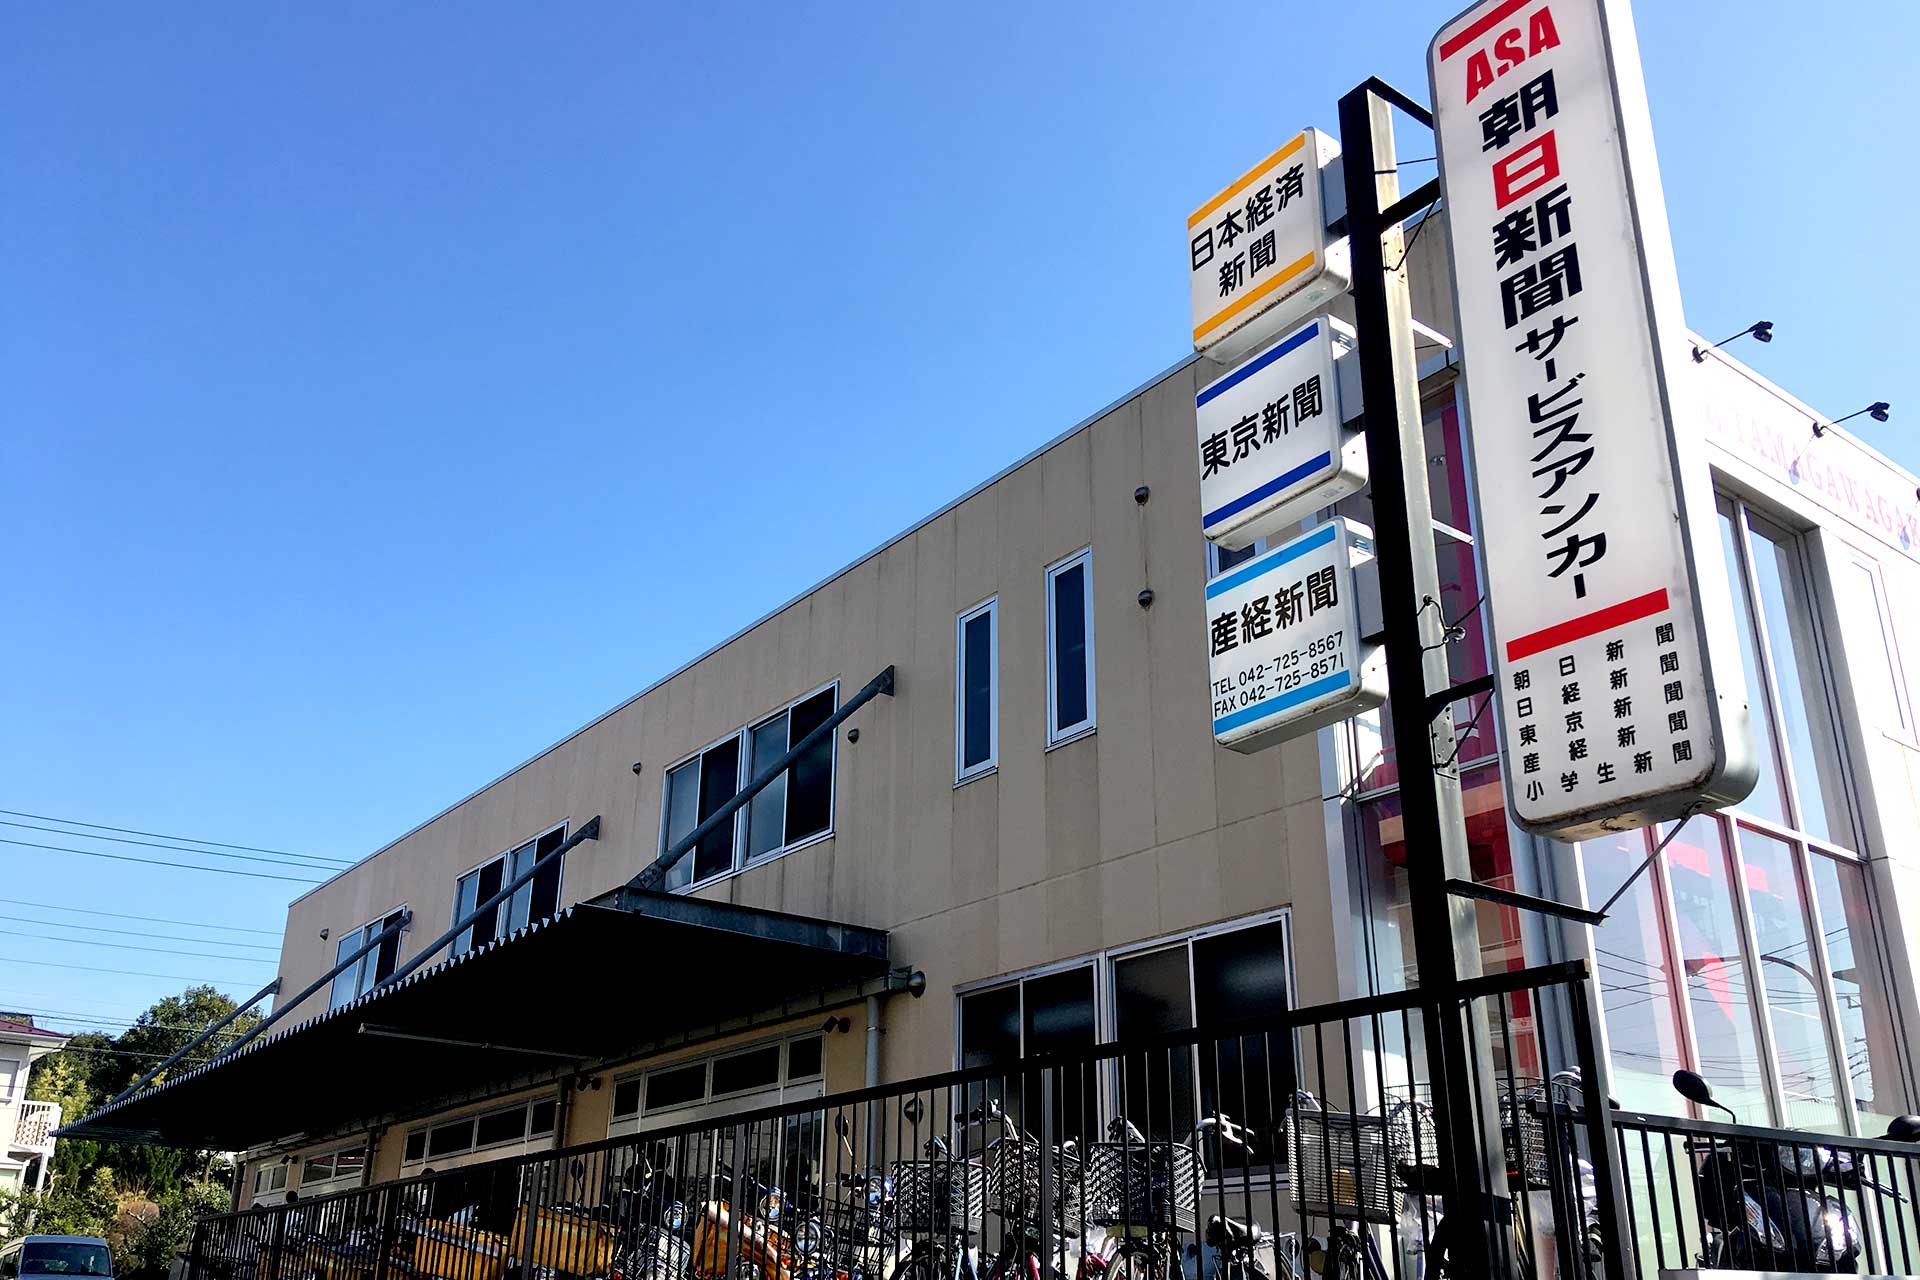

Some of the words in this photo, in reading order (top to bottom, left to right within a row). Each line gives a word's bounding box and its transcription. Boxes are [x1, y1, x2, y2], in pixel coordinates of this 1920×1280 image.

[1466, 6, 1560, 105] ASA
[1191, 163, 1304, 271] 日本経済
[1219, 230, 1276, 297] 新聞
[1201, 374, 1323, 480] 東京新聞
[1211, 565, 1338, 657] 産経新聞
[1213, 677, 1236, 697] TEL
[1239, 631, 1343, 686] 042-725-8567
[1214, 695, 1237, 717] FAX
[1240, 652, 1344, 706] 042-725-8571
